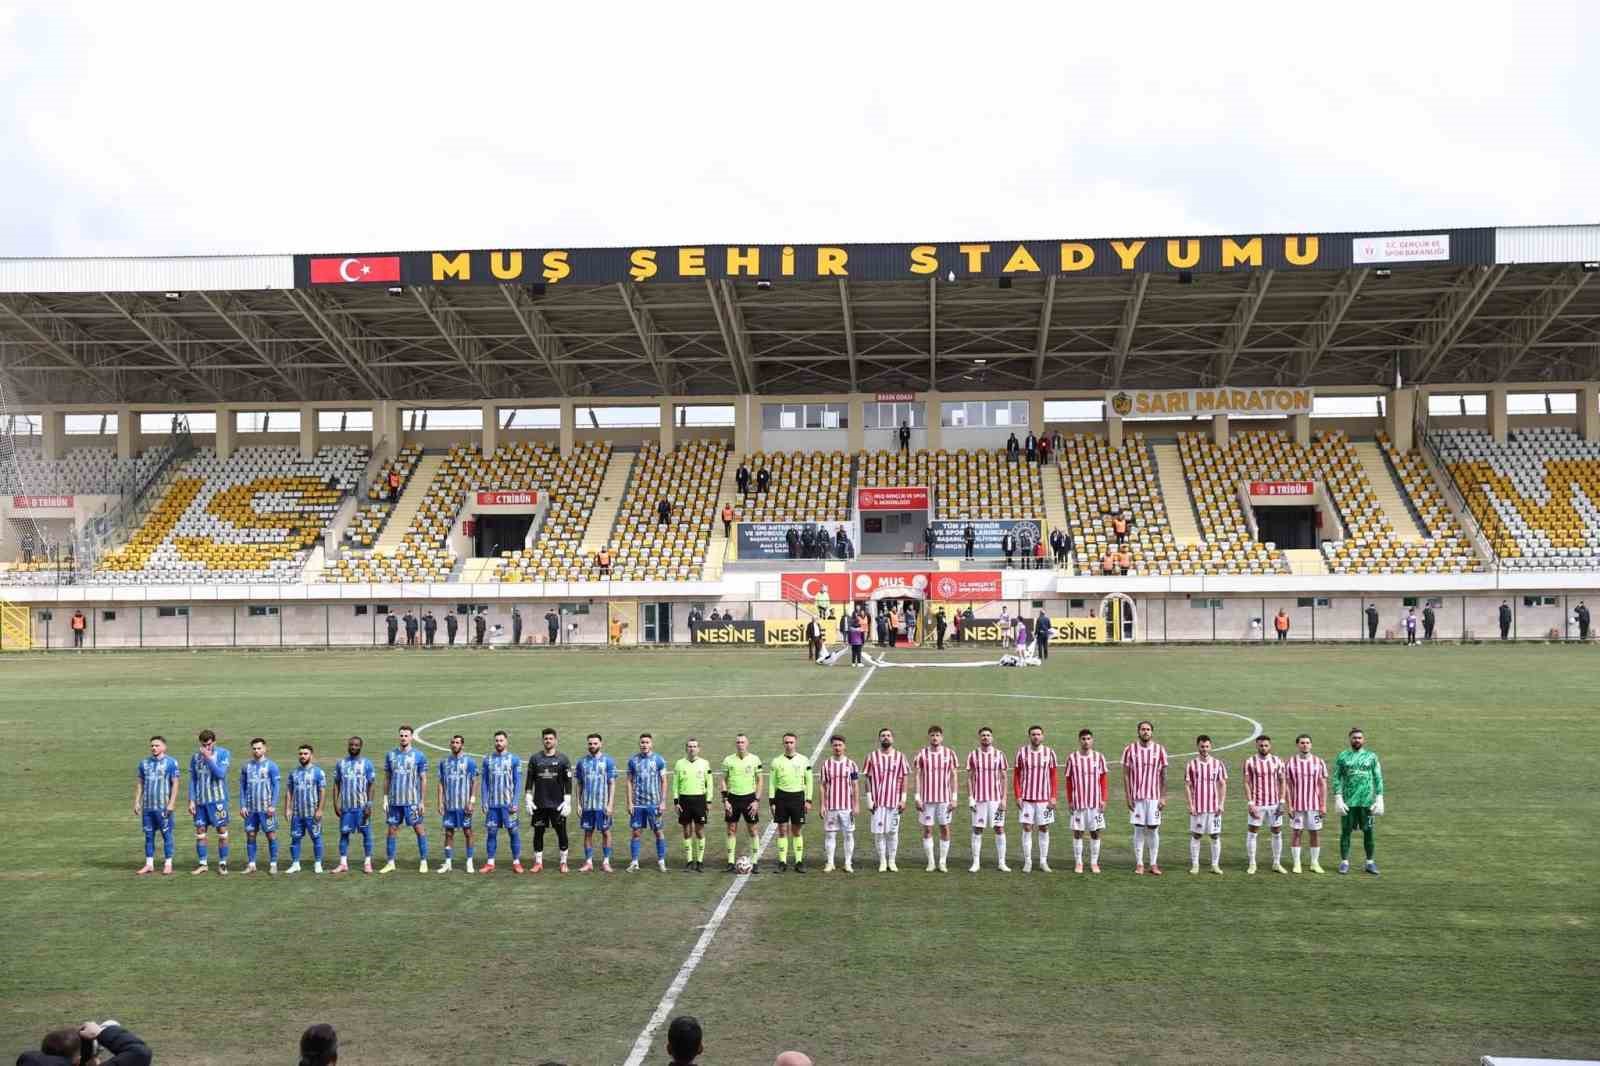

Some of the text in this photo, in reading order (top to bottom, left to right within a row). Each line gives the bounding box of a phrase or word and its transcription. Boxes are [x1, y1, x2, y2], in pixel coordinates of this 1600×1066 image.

[432, 237, 1319, 283] MUŞ ŞEHİR STADYUMU
[1136, 390, 1309, 413] SARI MARATON
